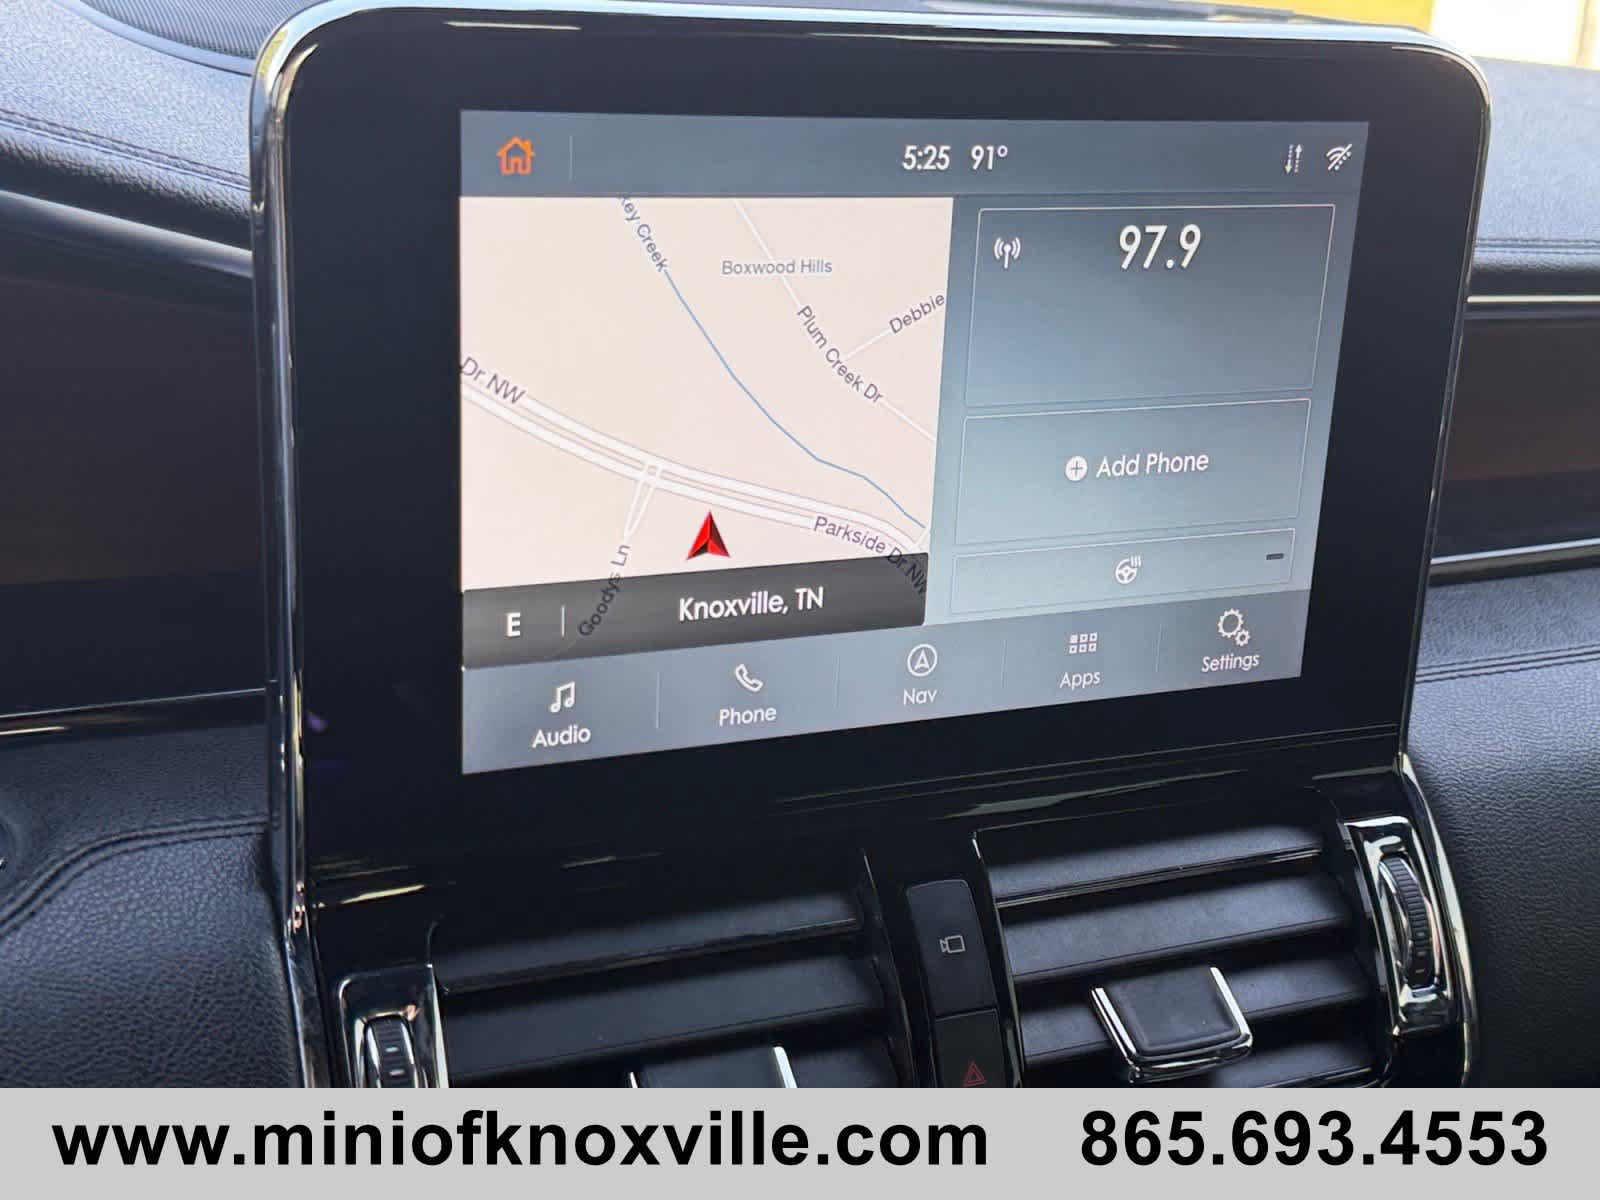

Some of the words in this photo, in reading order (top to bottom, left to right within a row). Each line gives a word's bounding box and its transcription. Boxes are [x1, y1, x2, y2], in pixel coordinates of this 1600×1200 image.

[902, 145, 951, 171] 5:25
[637, 223, 668, 273] Creek
[1119, 223, 1202, 270] 97.9
[721, 259, 796, 276] Boxwood
[800, 258, 833, 274] Hills
[889, 292, 946, 335] Debbie
[797, 305, 828, 349] Plum
[825, 347, 864, 392] Creek
[863, 382, 884, 404] Dr
[460, 356, 486, 381] Dr
[486, 373, 527, 404] NW
[1096, 454, 1140, 478] Add
[1146, 451, 1210, 475] Phone
[813, 515, 886, 554] Parkside
[887, 546, 908, 569] Dr
[578, 571, 622, 637] Goodys
[610, 544, 631, 567] Ln
[678, 590, 789, 622] Knoxville,
[796, 586, 824, 611] TN
[506, 612, 521, 637] E
[1201, 652, 1260, 674] Settings
[1059, 669, 1101, 690] Apps
[904, 687, 938, 706] Nav
[719, 704, 778, 727] Phone
[532, 724, 592, 749] Audio
